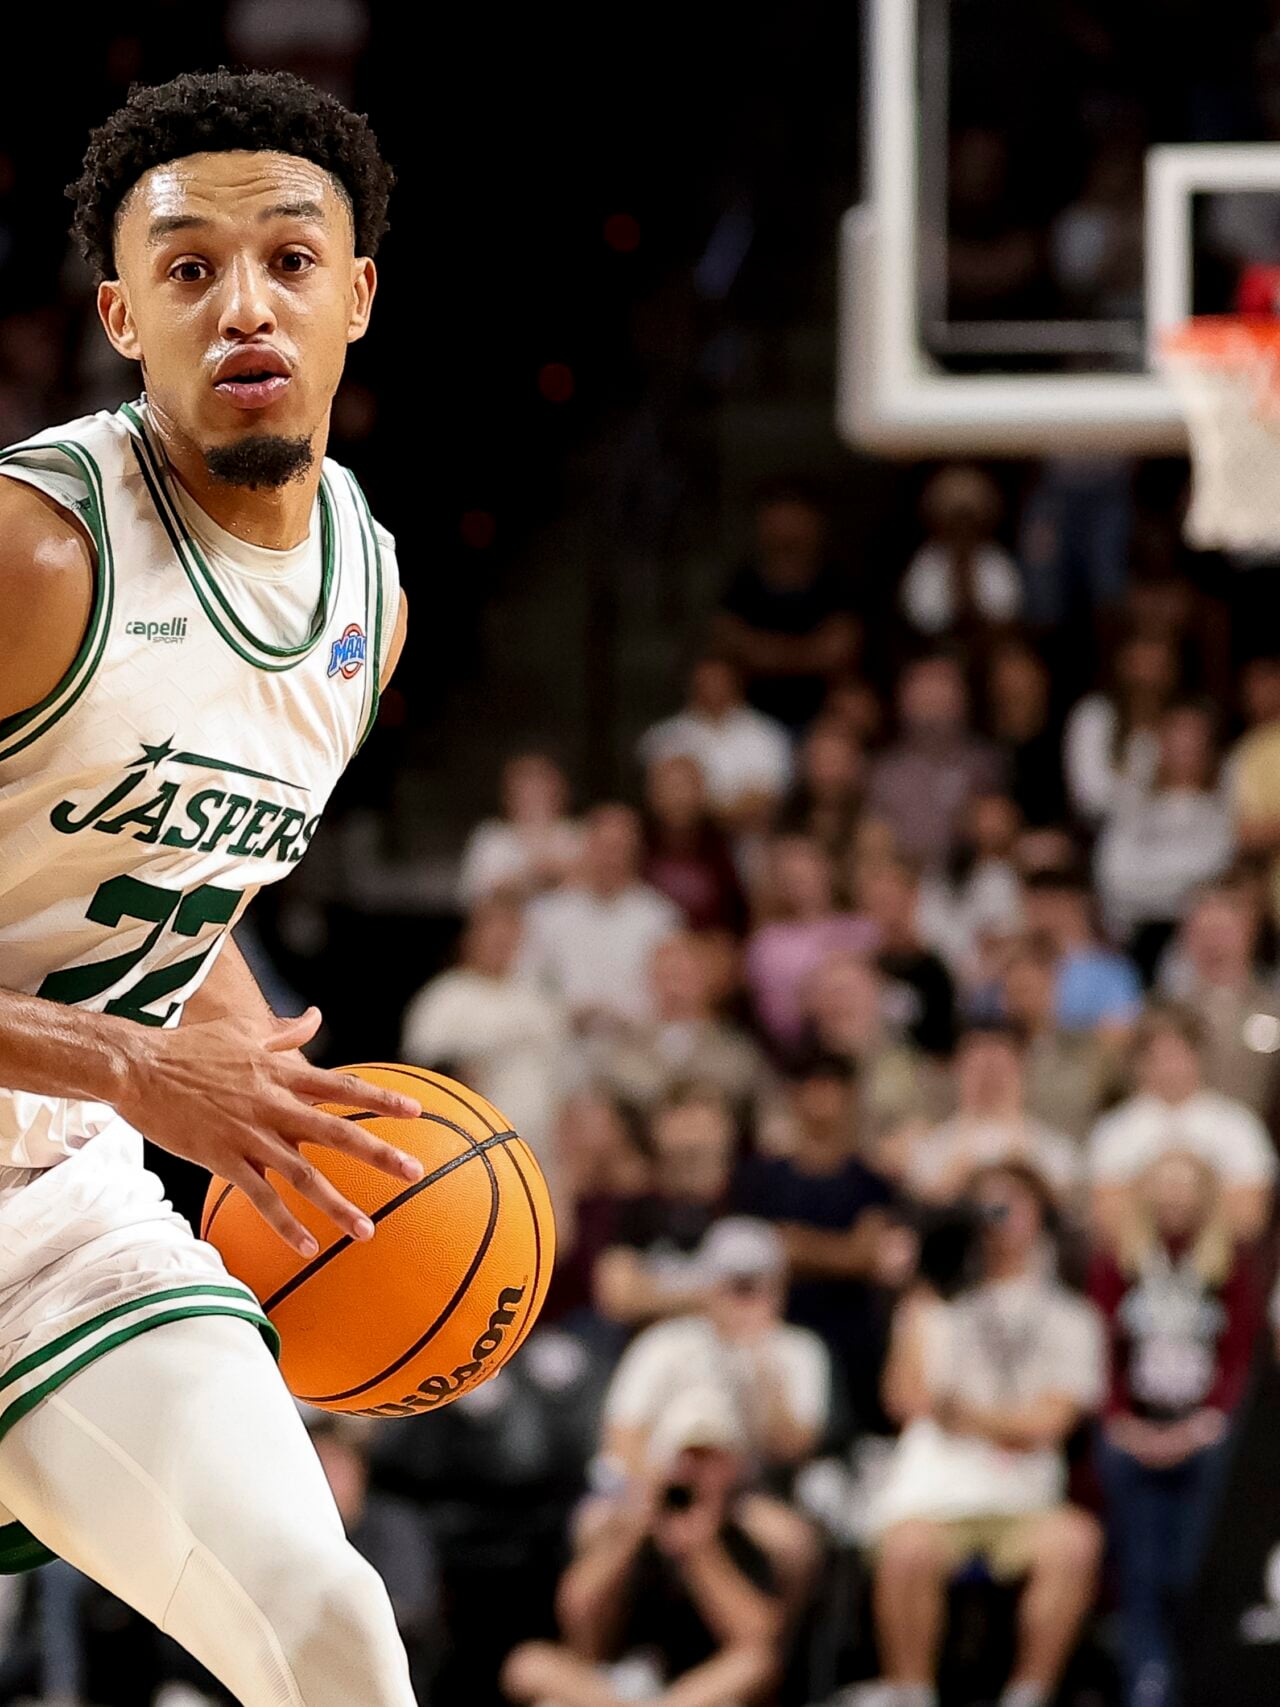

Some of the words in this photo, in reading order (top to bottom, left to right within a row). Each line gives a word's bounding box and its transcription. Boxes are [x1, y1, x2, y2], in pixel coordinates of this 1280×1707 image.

[125, 617, 188, 641] capelli
[152, 636, 185, 645] SPORT
[37, 874, 244, 1030] 22
